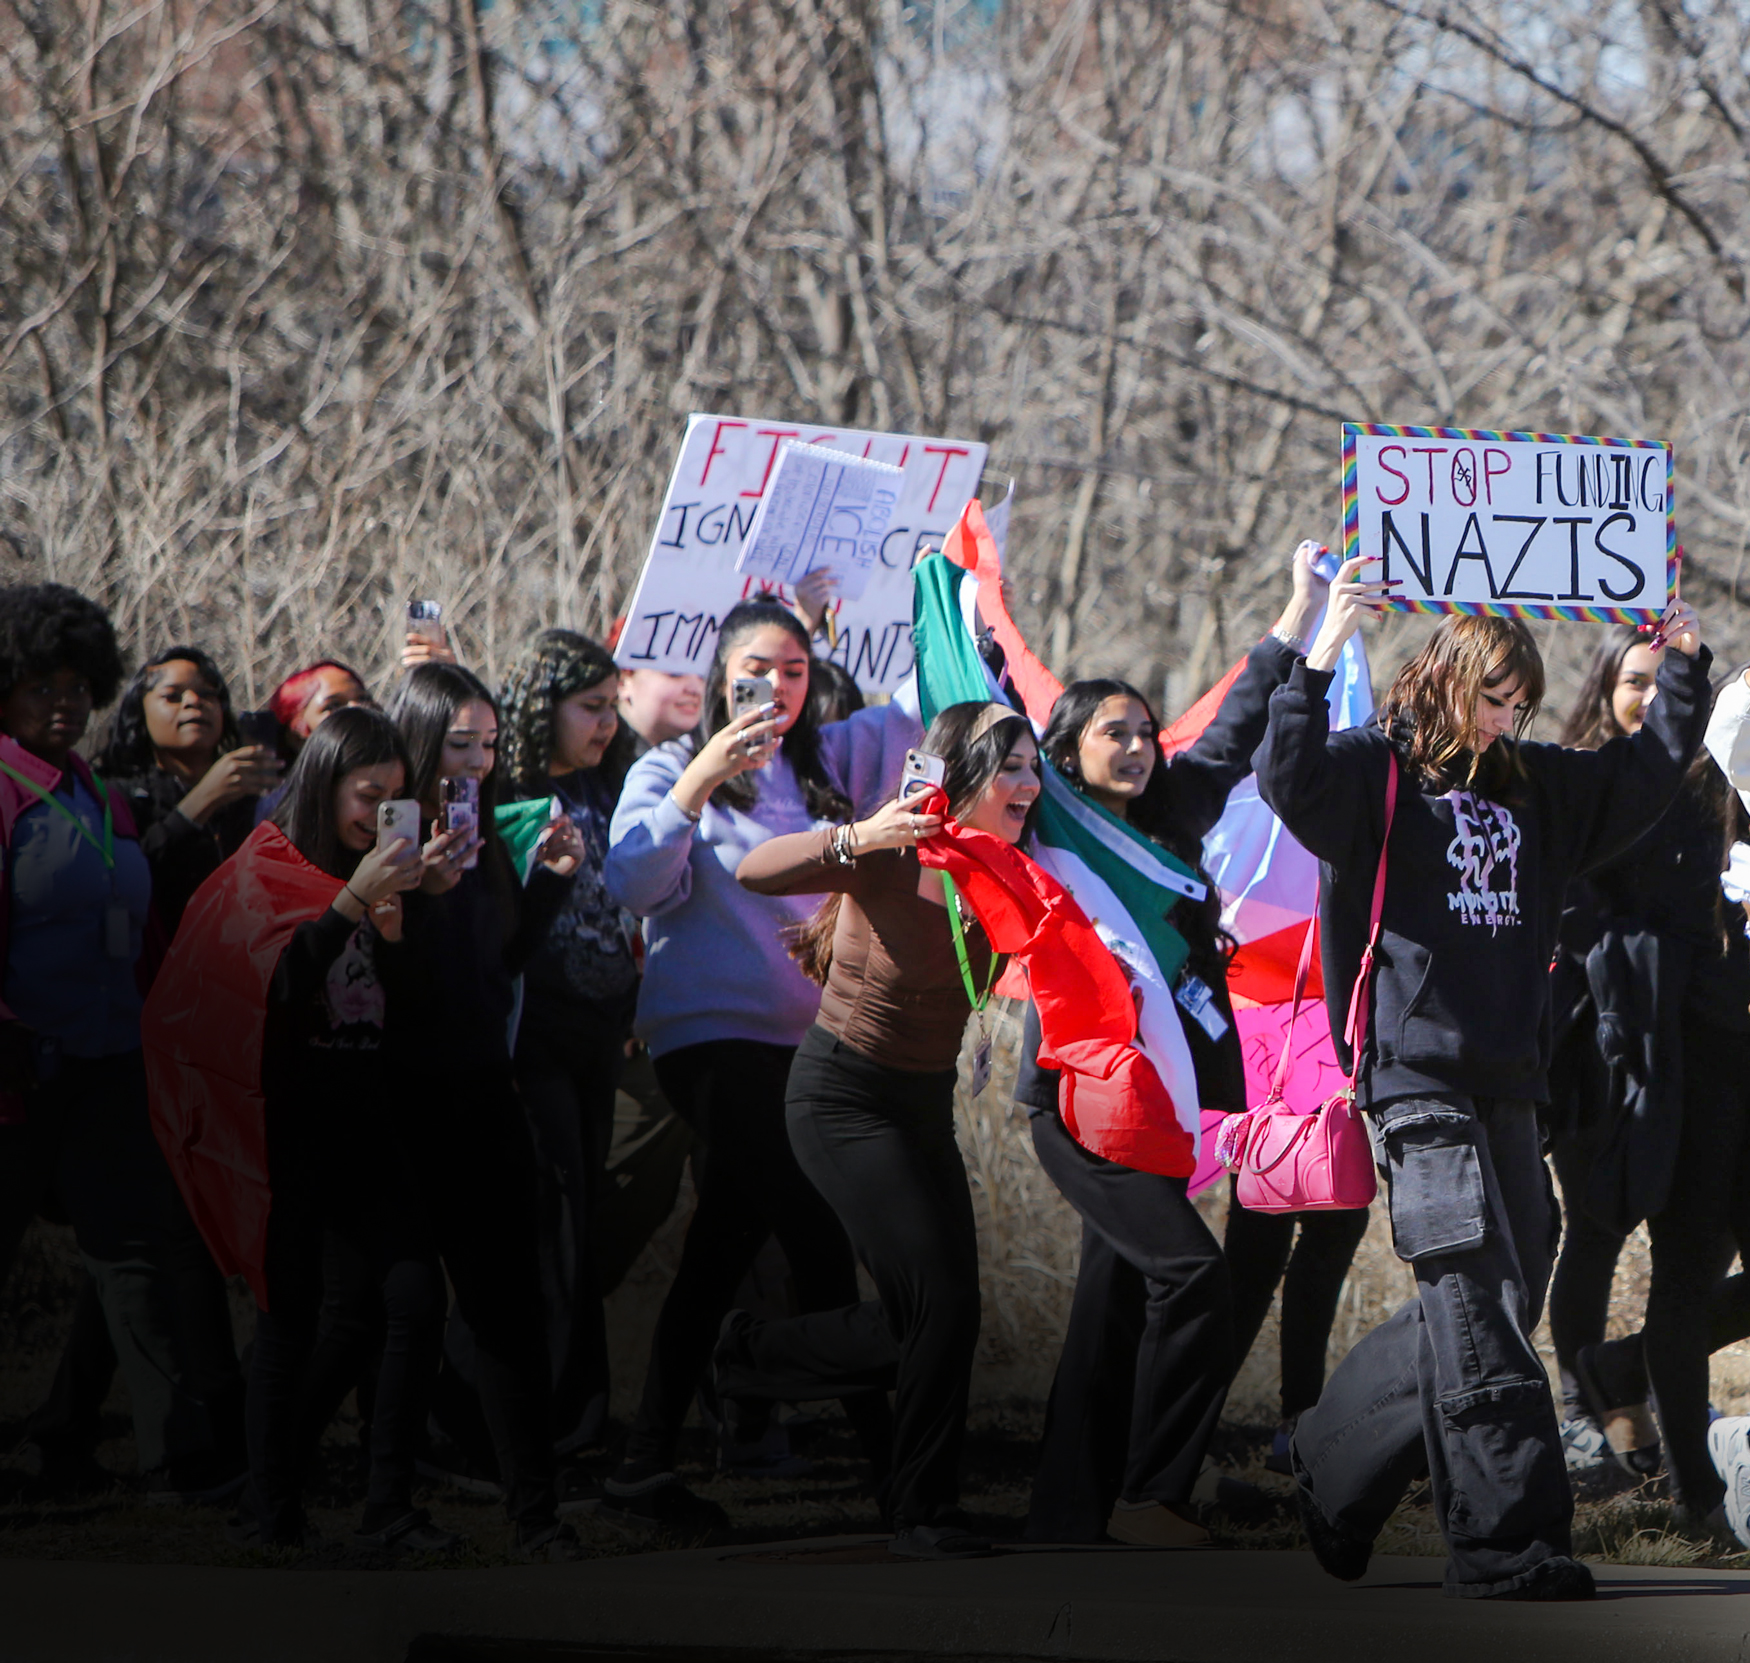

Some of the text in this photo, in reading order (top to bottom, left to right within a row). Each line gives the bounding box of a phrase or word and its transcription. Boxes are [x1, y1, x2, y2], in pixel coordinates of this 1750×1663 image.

[700, 422, 969, 513] FIT
[1376, 445, 1664, 513] STOP FUNDING
[822, 503, 868, 559] ICE
[855, 488, 898, 569] ABOLISH
[1381, 511, 1646, 602] NAZIS
[1460, 914, 1517, 926] ENERGY
